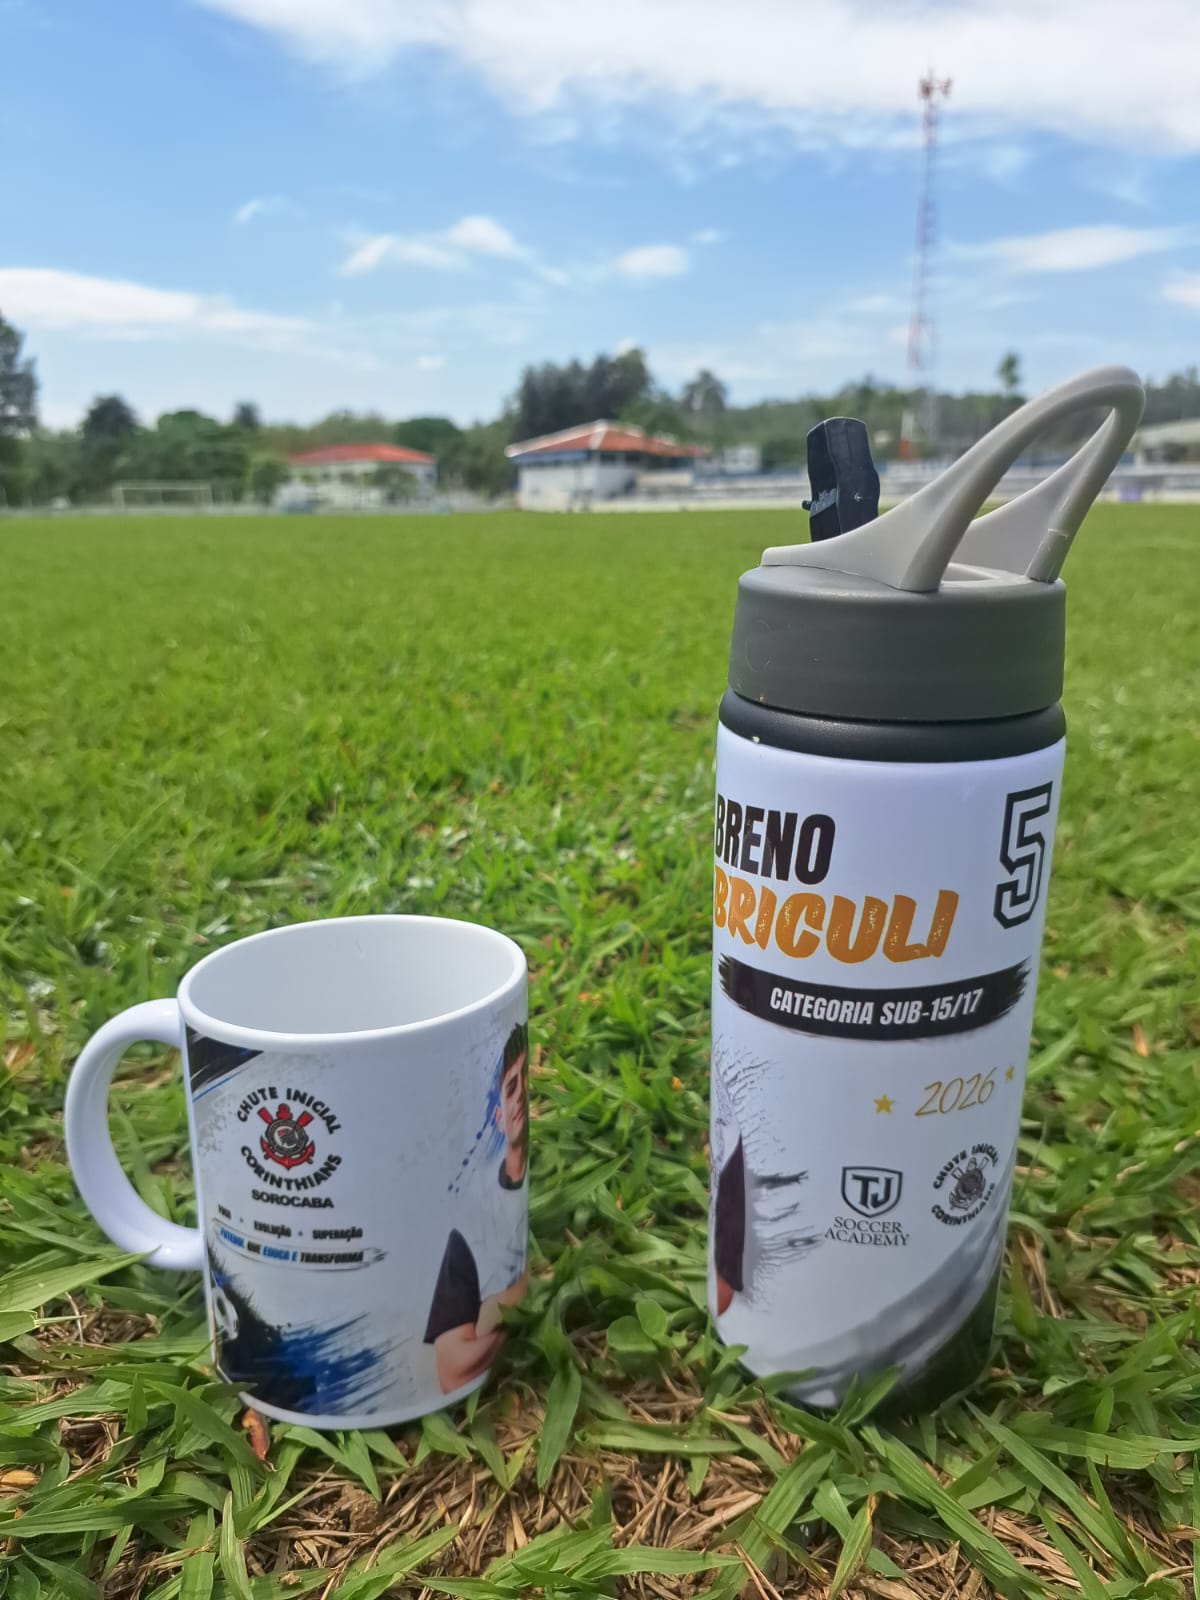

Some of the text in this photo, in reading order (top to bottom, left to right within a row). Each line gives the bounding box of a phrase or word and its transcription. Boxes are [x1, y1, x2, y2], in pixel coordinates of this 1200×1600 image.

[714, 793, 836, 885] BRENO
[993, 781, 1053, 929] 5
[770, 987, 984, 1025] CATEGORIA SUB-15/17
[237, 1086, 342, 1135] CHUTE INICIAL
[914, 1066, 998, 1117] 2026
[240, 1145, 343, 1191] CORINTHIANS
[932, 1149, 967, 1190] CHUTE
[251, 1189, 335, 1209] SOROCABA
[851, 1174, 893, 1209] TJ
[824, 1227, 909, 1246] ACADEMY
[833, 1216, 902, 1233] SOCCER
